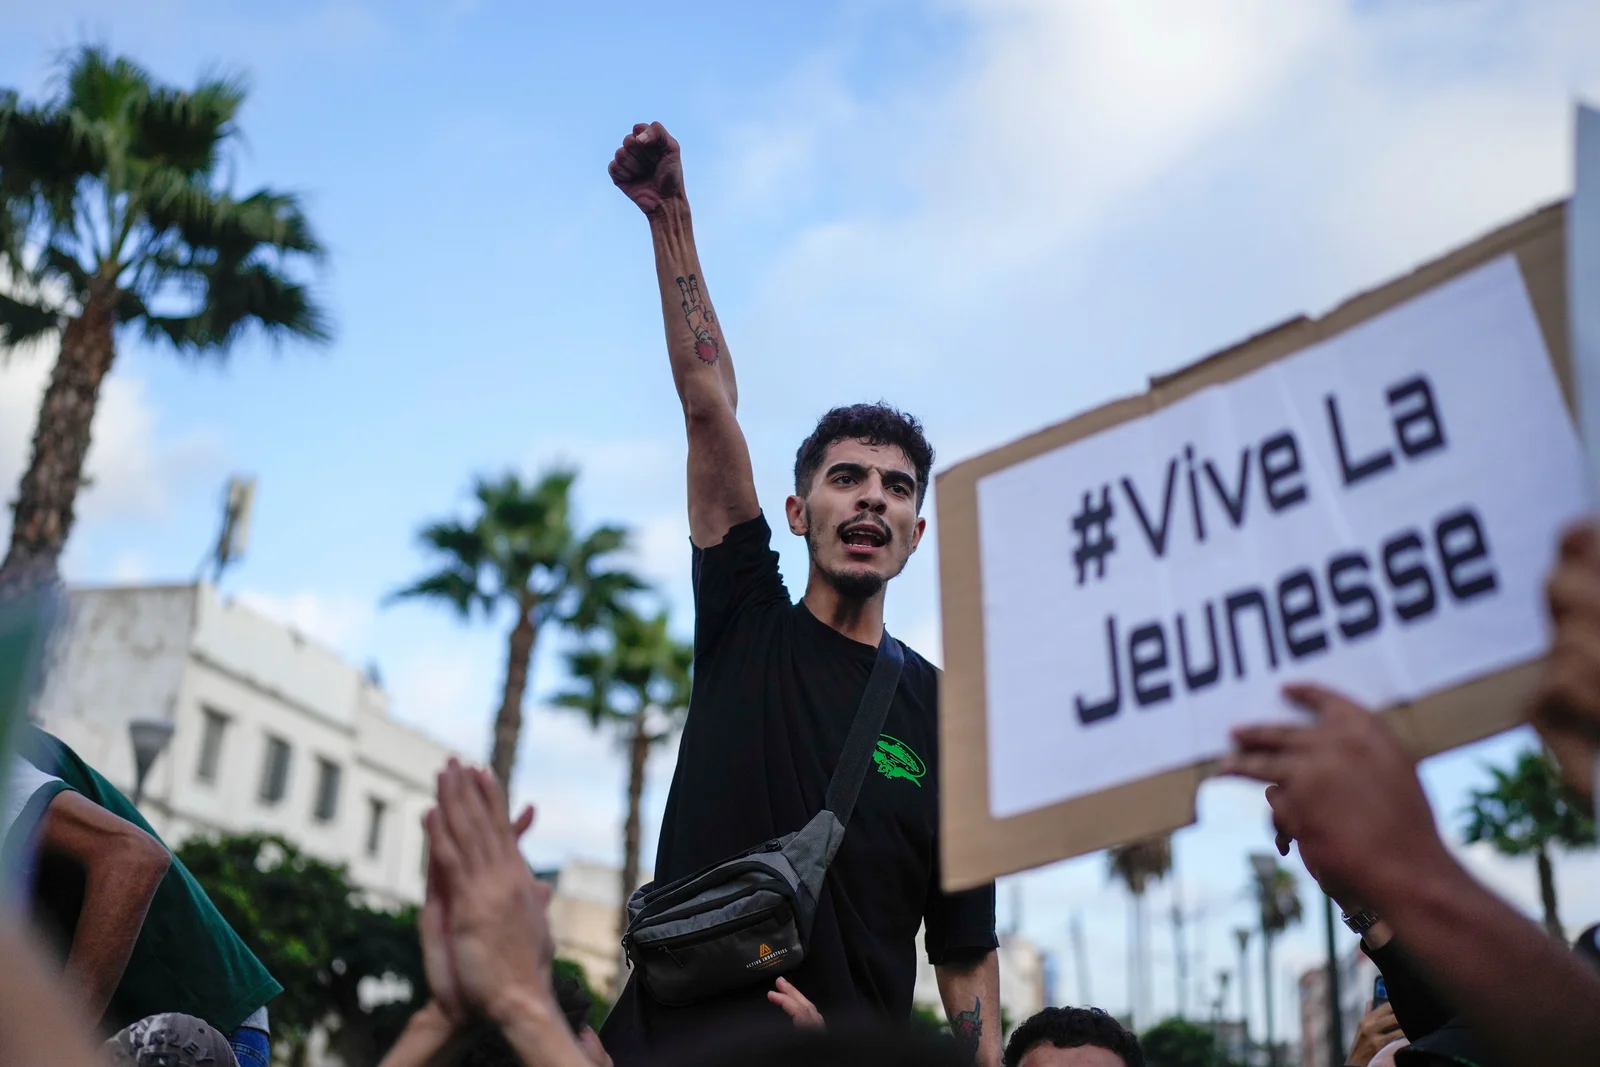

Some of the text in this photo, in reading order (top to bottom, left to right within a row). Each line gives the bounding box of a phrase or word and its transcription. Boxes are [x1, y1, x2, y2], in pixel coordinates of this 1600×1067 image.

[1071, 374, 1448, 586] #Vive La
[1073, 506, 1500, 726] Jeunesse
